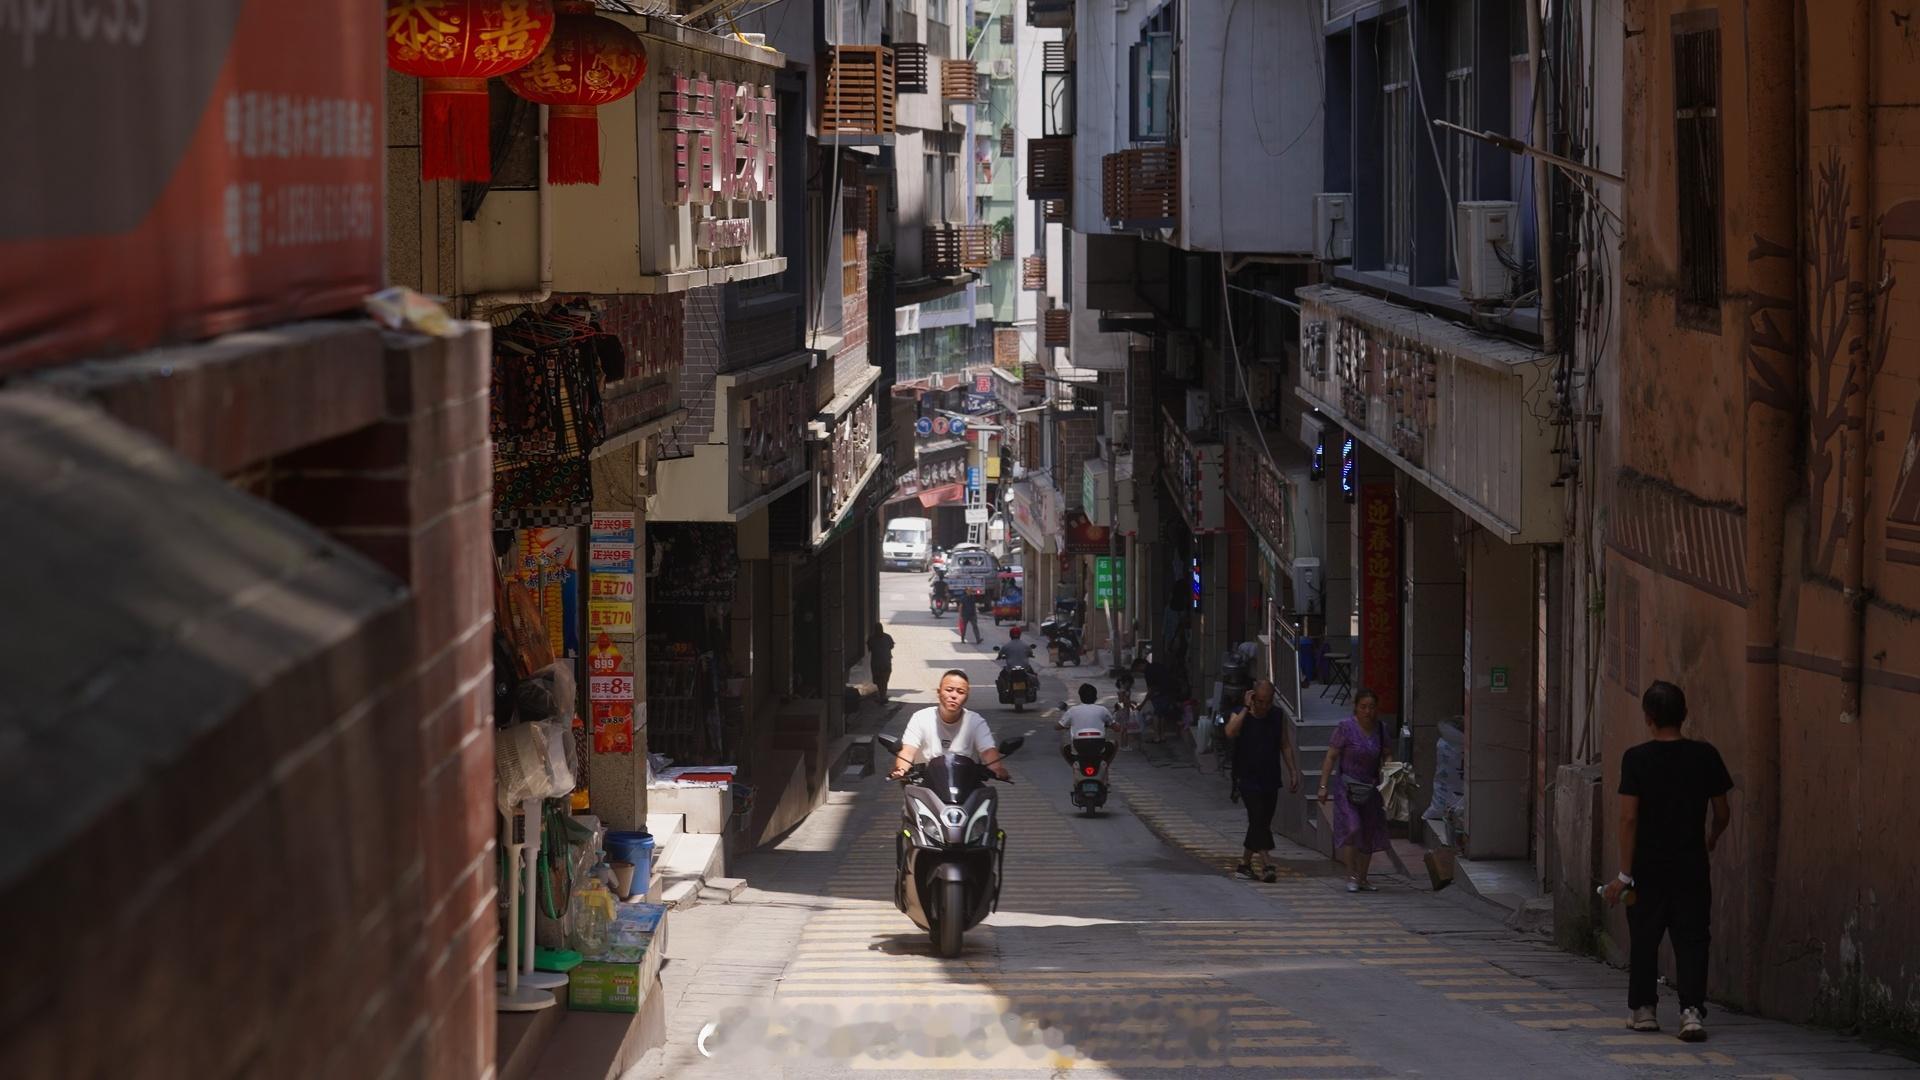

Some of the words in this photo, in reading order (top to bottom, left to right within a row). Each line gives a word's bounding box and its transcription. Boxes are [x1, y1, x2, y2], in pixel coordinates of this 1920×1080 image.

[592, 518, 632, 530] 正兴9号
[592, 549, 631, 561] 正兴9号
[594, 658, 614, 669] 899
